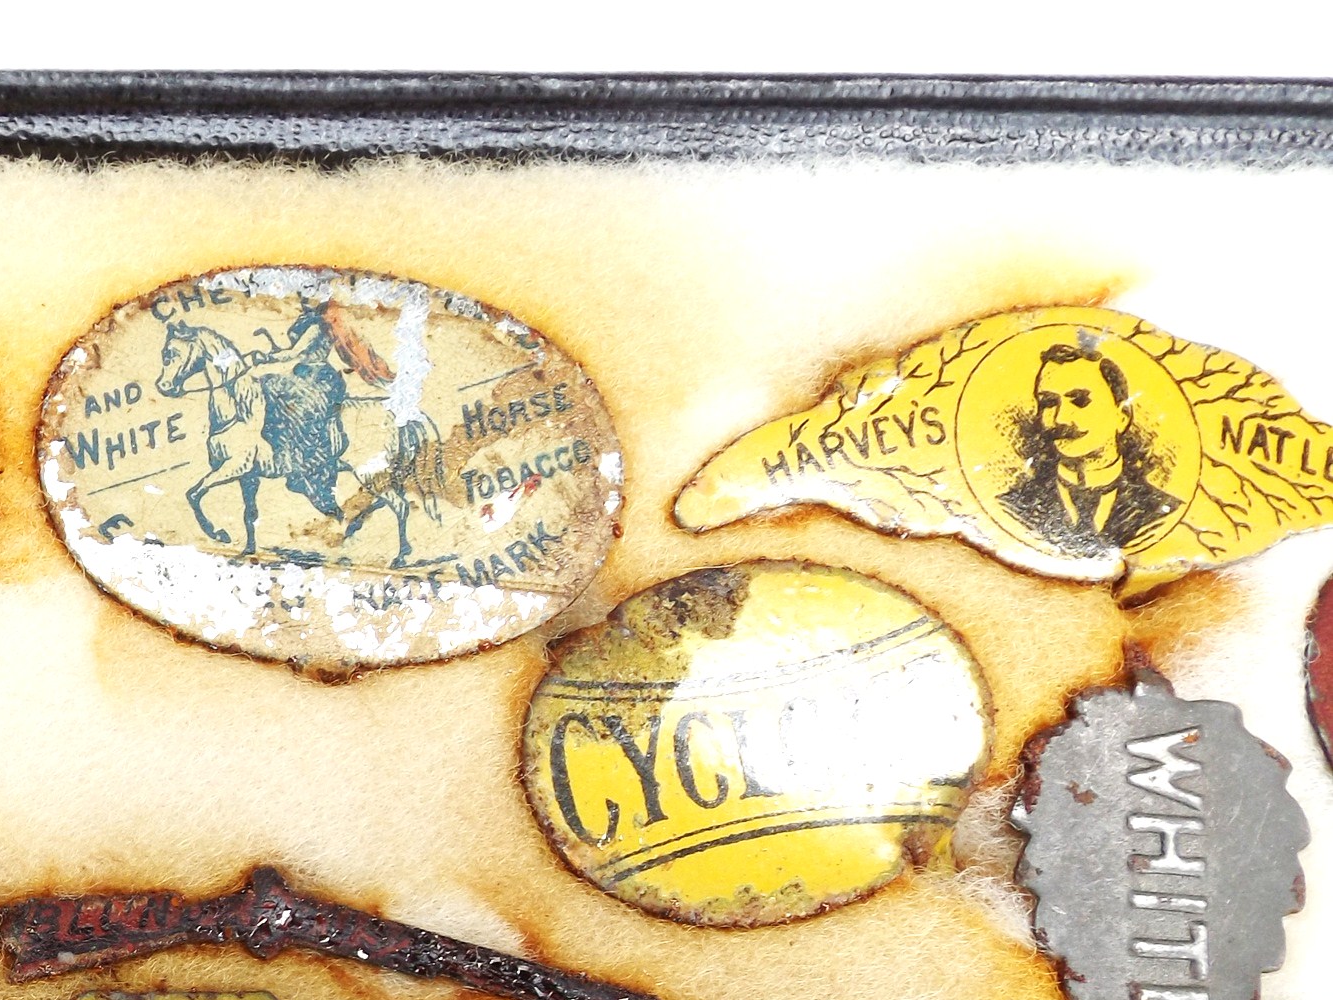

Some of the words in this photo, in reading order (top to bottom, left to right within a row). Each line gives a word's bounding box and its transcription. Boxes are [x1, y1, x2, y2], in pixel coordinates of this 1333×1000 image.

[83, 380, 146, 420] AND
[460, 382, 574, 439] HORSE
[65, 411, 187, 472] WHITE
[459, 437, 594, 506] TOBACCO
[761, 399, 947, 485] HARVEY'S
